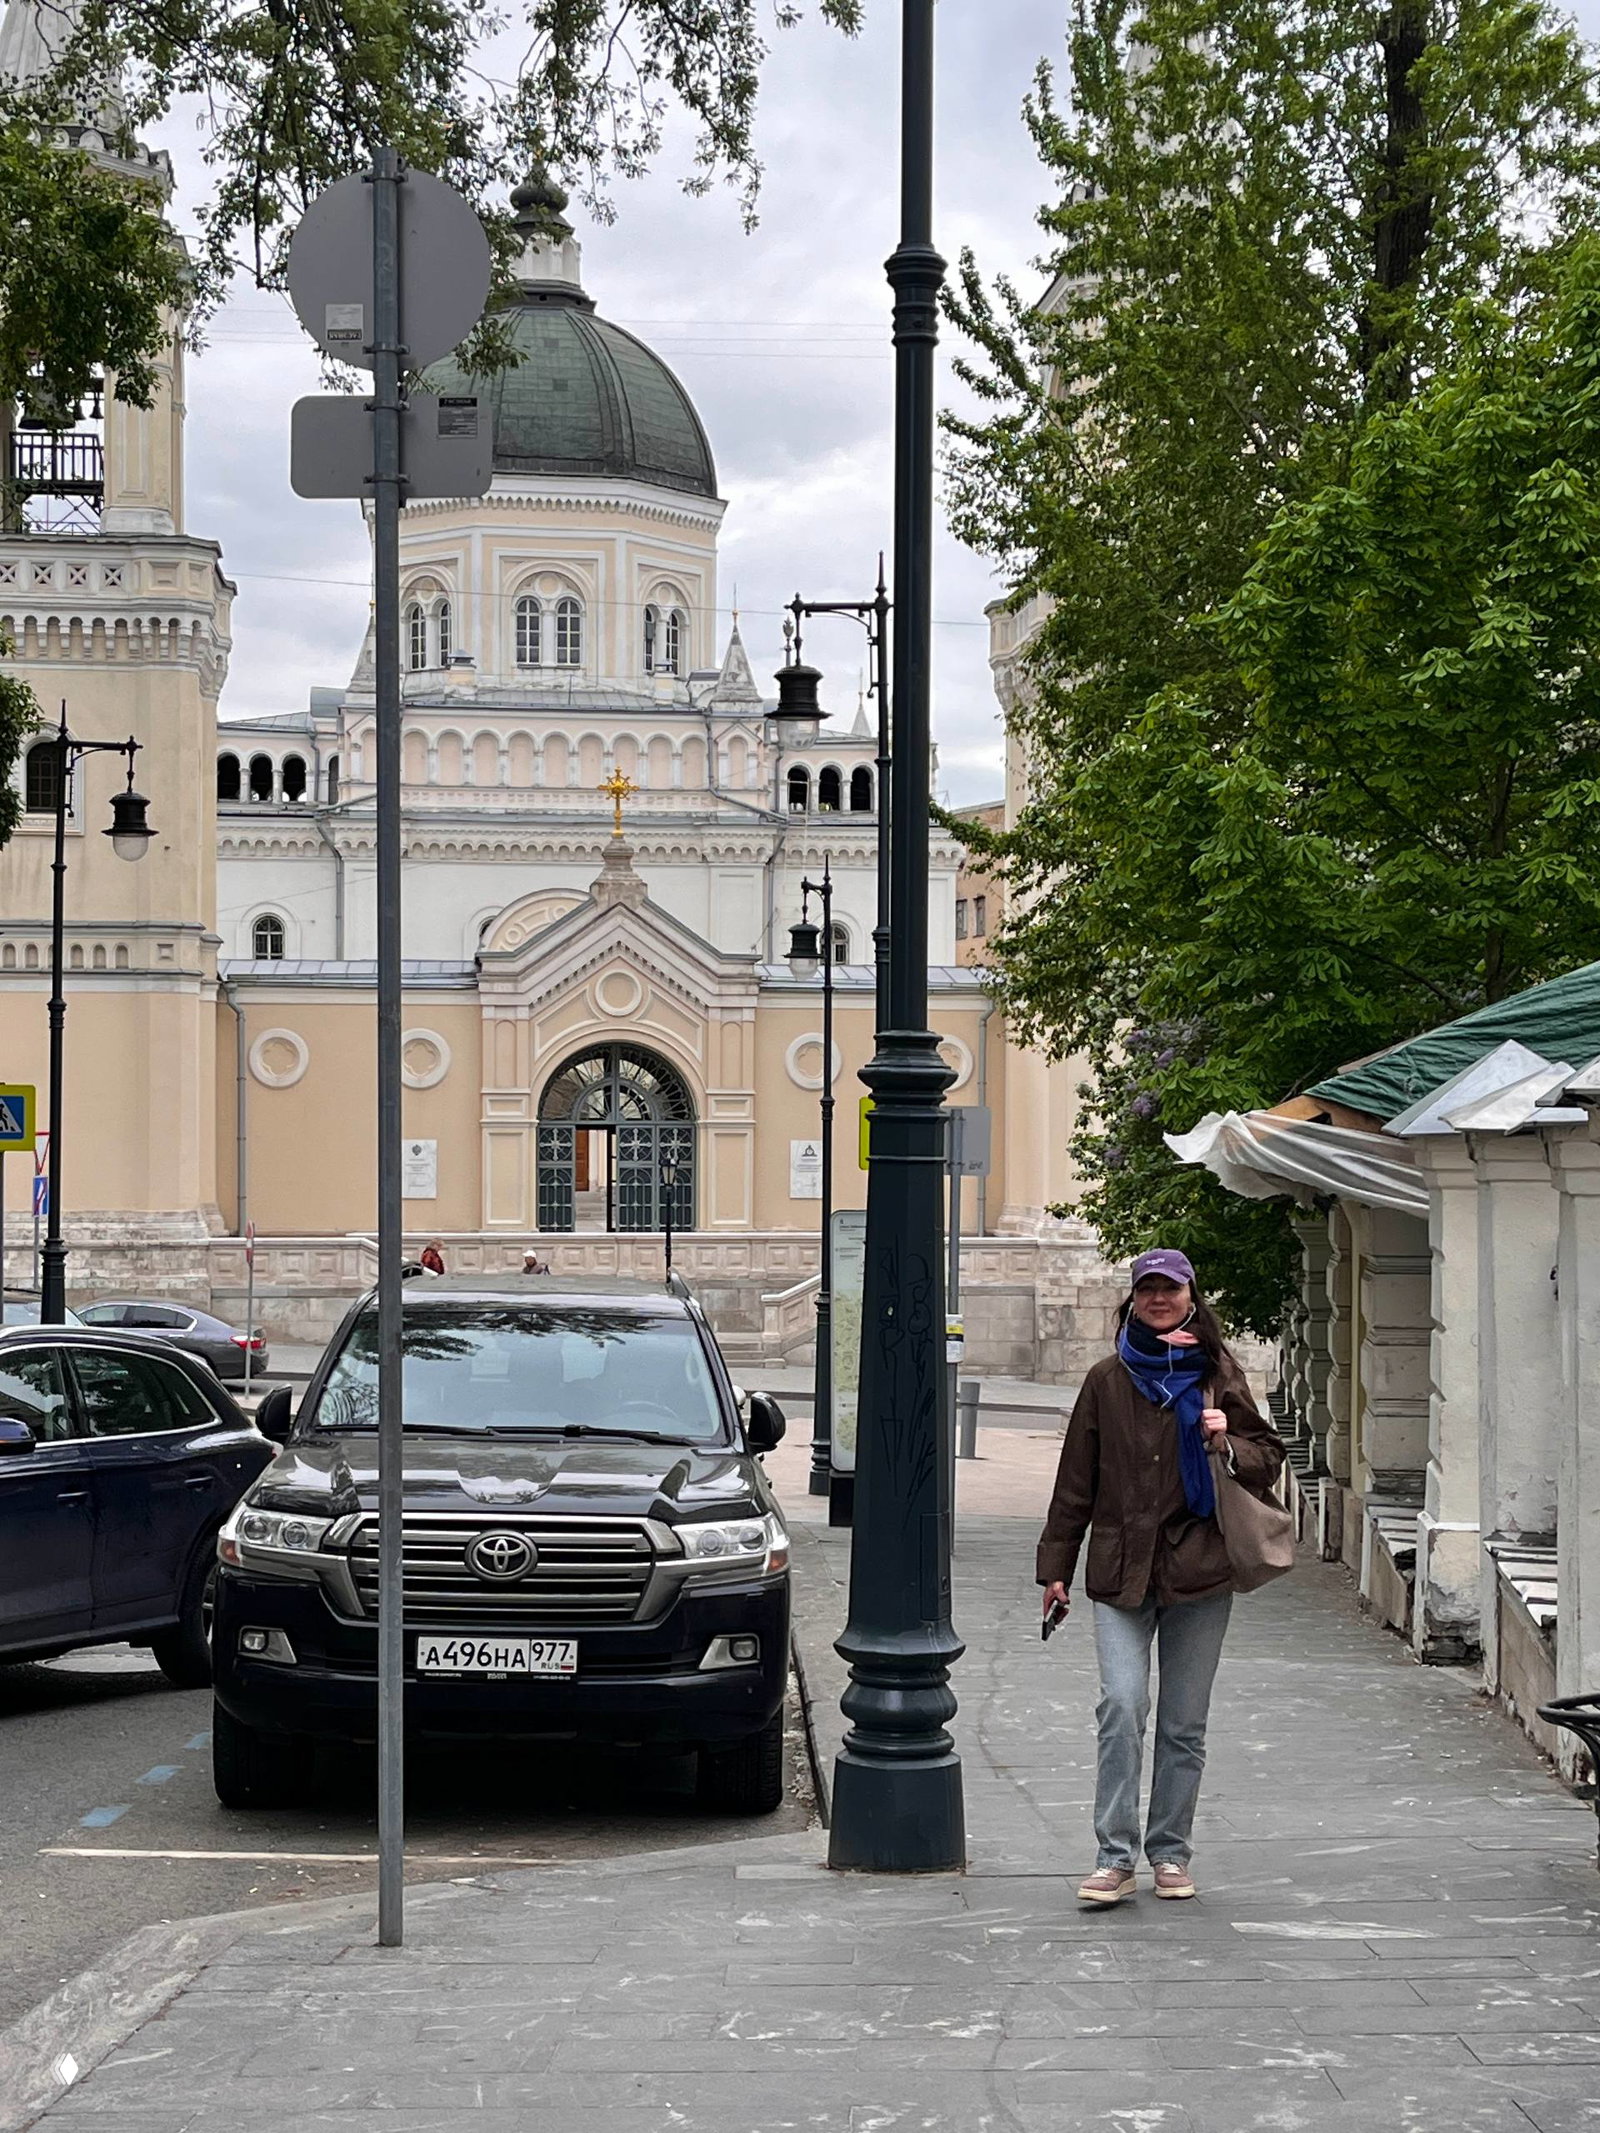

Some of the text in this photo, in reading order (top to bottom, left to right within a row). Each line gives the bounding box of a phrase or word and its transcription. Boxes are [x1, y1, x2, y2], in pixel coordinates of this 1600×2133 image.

[425, 1640, 570, 1668] А496НА 977
[541, 1662, 560, 1670] RUS
